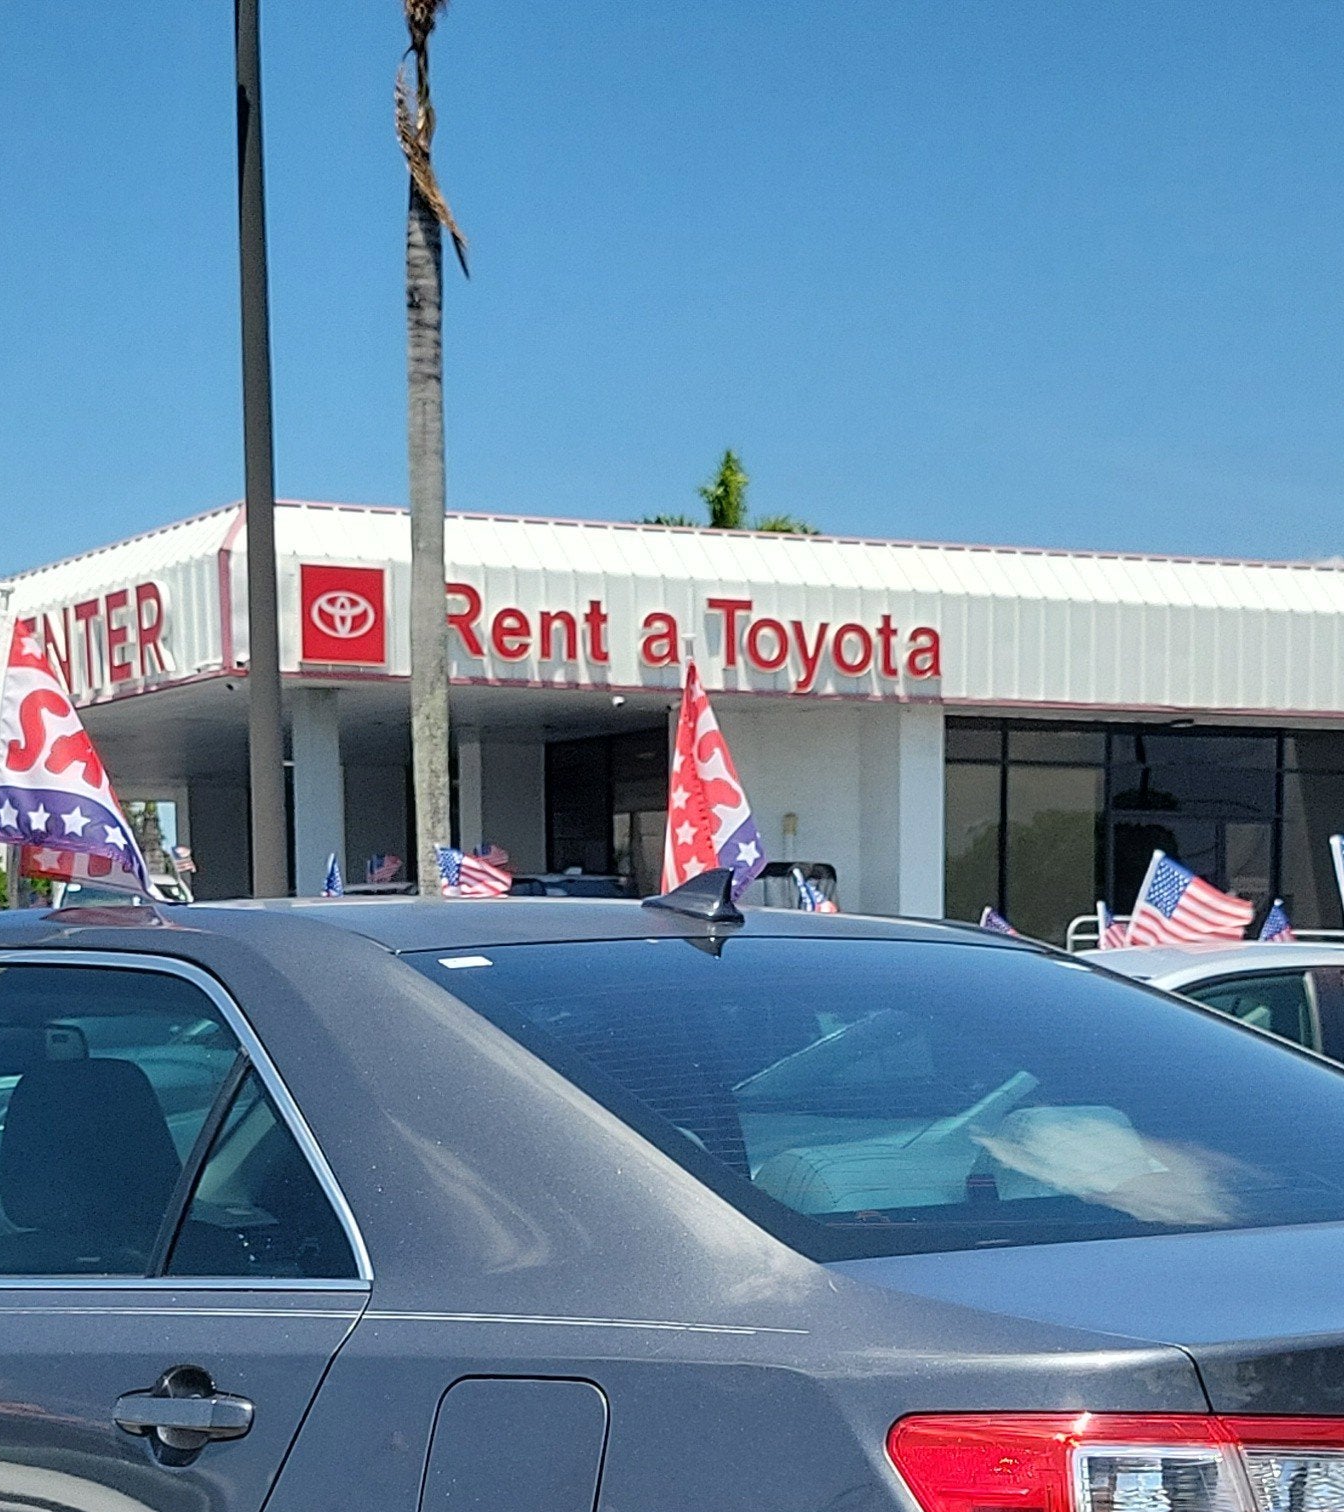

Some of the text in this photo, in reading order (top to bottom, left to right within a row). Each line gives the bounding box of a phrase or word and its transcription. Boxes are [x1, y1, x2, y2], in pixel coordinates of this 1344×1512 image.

[446, 582, 942, 693] Rent a Toyota
